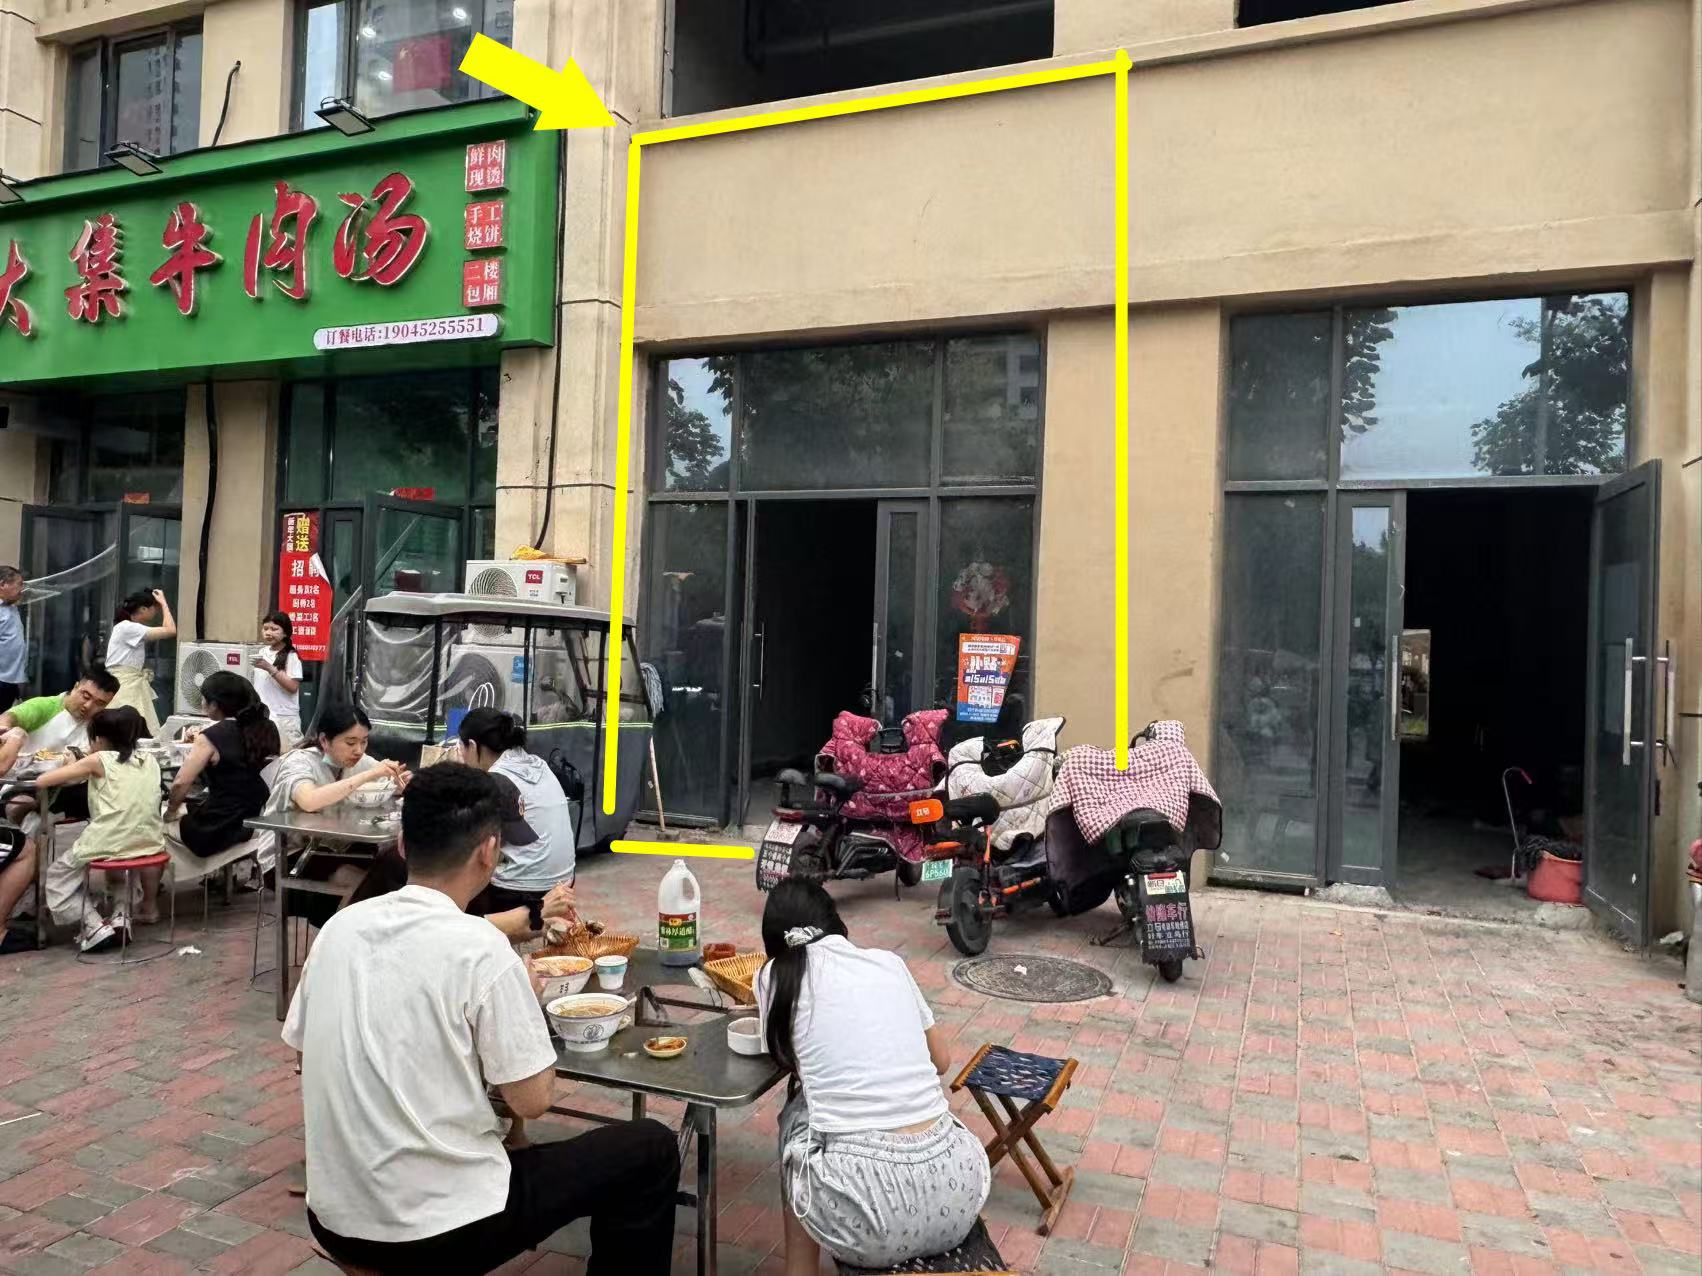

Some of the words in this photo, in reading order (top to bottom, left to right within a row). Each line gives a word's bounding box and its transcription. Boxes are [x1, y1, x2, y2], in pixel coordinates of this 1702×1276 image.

[470, 145, 502, 165] 鲜肉
[469, 166, 501, 187] 现烫
[468, 204, 500, 224] 手工
[467, 226, 500, 246] 烧饼
[466, 262, 499, 280] 二楼
[466, 282, 498, 303] 包厢
